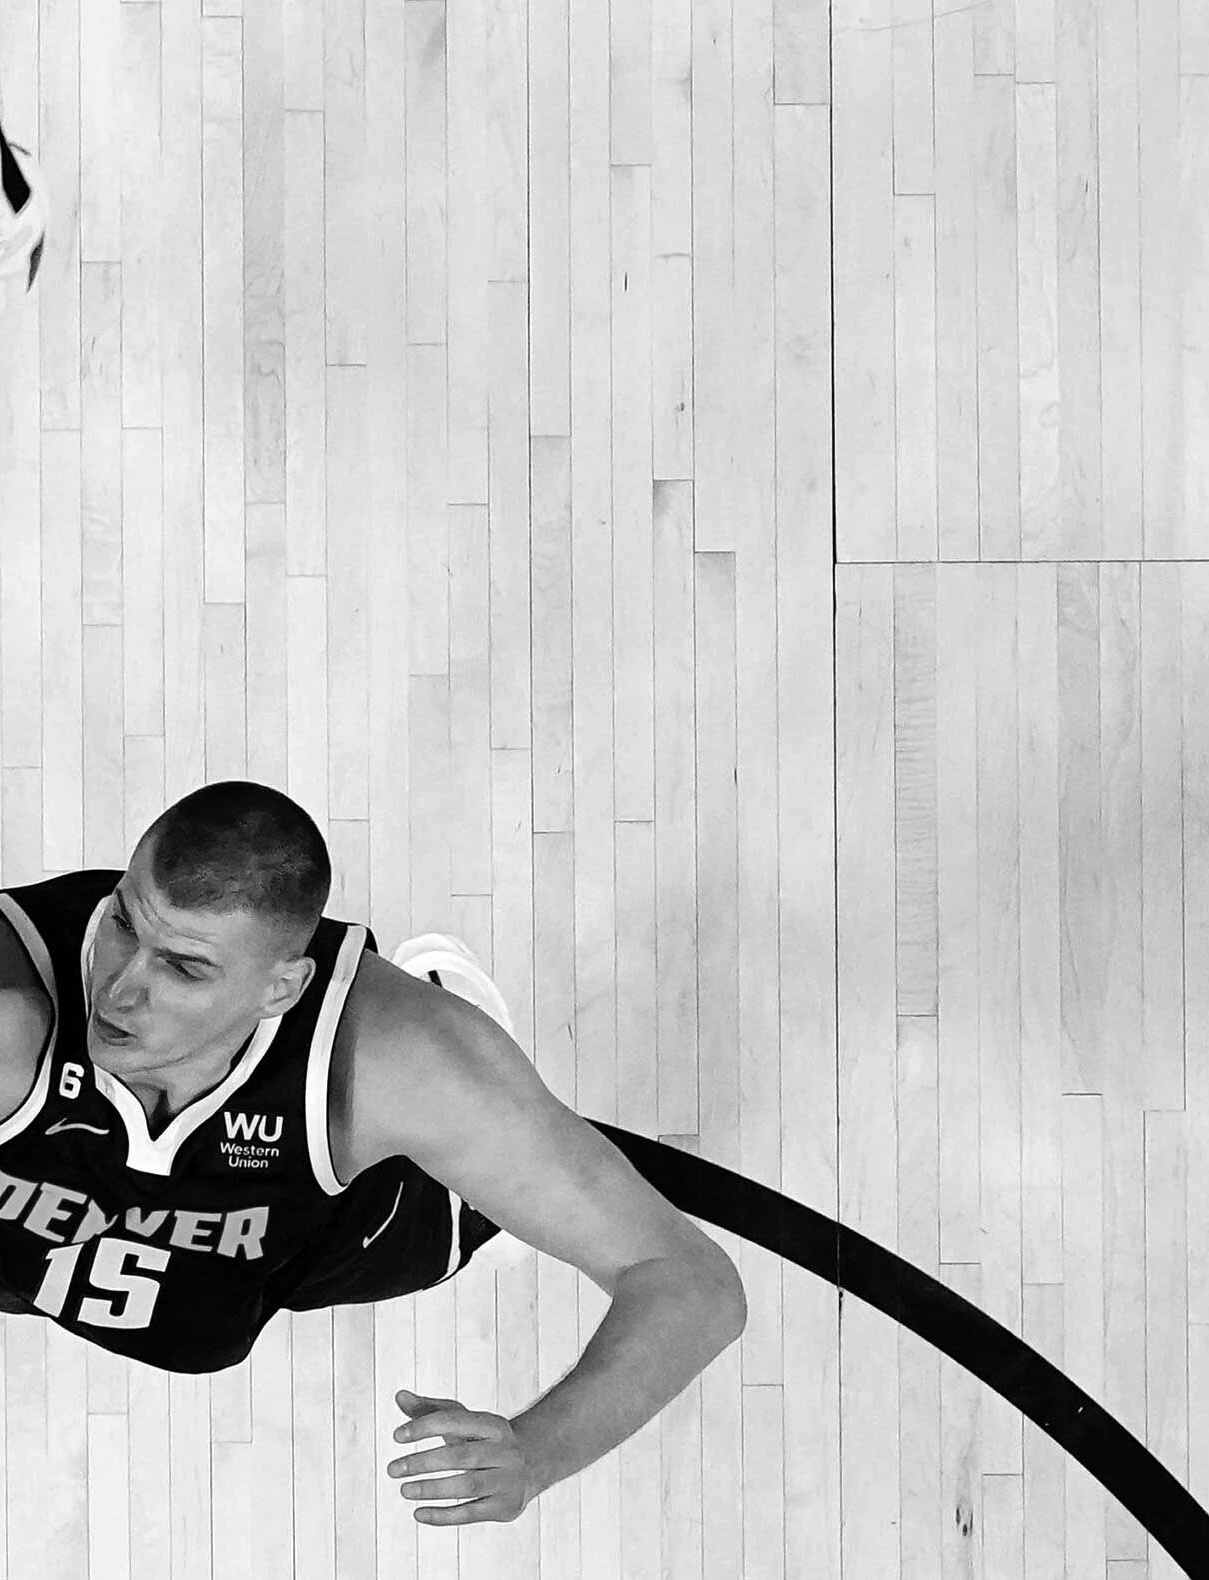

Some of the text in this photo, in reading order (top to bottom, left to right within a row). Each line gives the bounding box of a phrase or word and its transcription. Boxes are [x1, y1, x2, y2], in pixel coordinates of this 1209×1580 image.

[59, 1062, 84, 1099] 6
[224, 1112, 284, 1142] WU
[220, 1141, 280, 1157] Western
[228, 1155, 269, 1168] Union
[32, 1237, 172, 1330] 15
